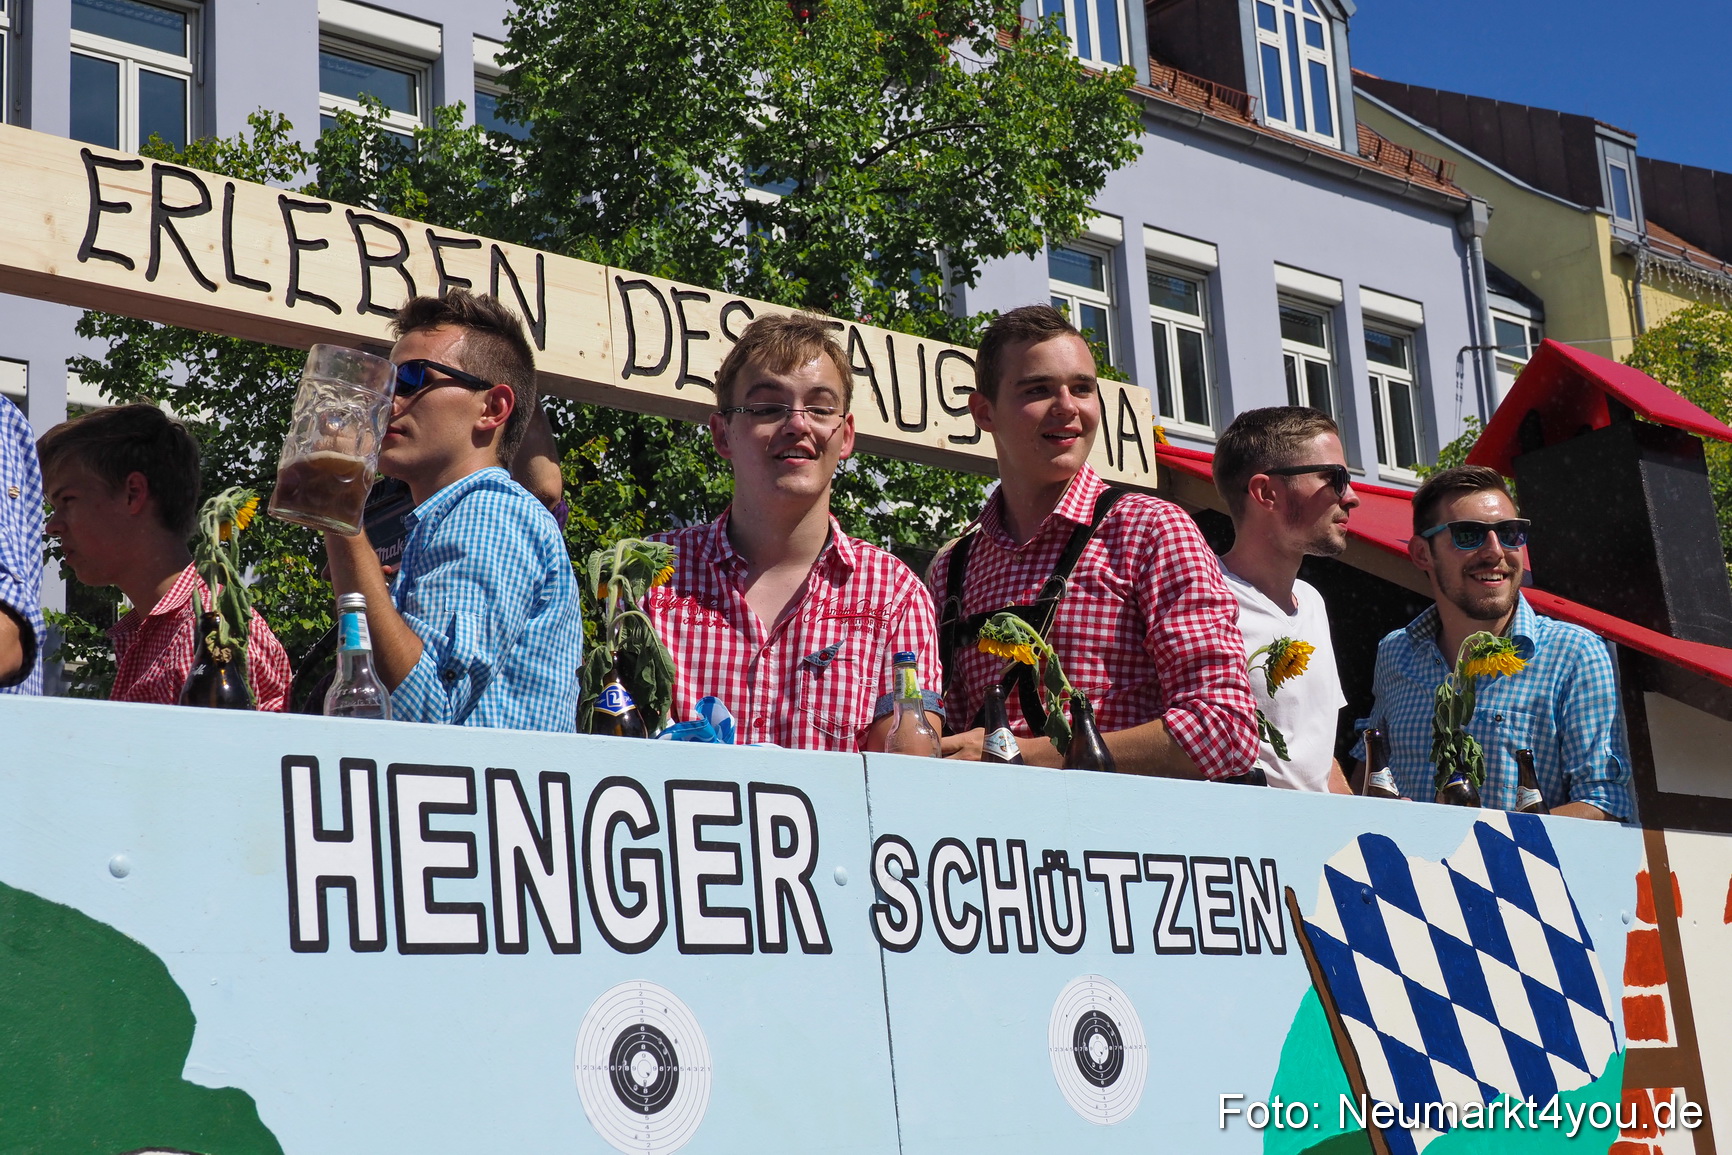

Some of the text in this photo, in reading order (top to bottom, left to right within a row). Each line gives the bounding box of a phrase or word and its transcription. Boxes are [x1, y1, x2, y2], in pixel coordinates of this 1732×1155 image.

[77, 147, 546, 352] ERLEBEN
[1096, 382, 1149, 474] A
[281, 754, 1288, 956] HENGER SCHÜTZEN
